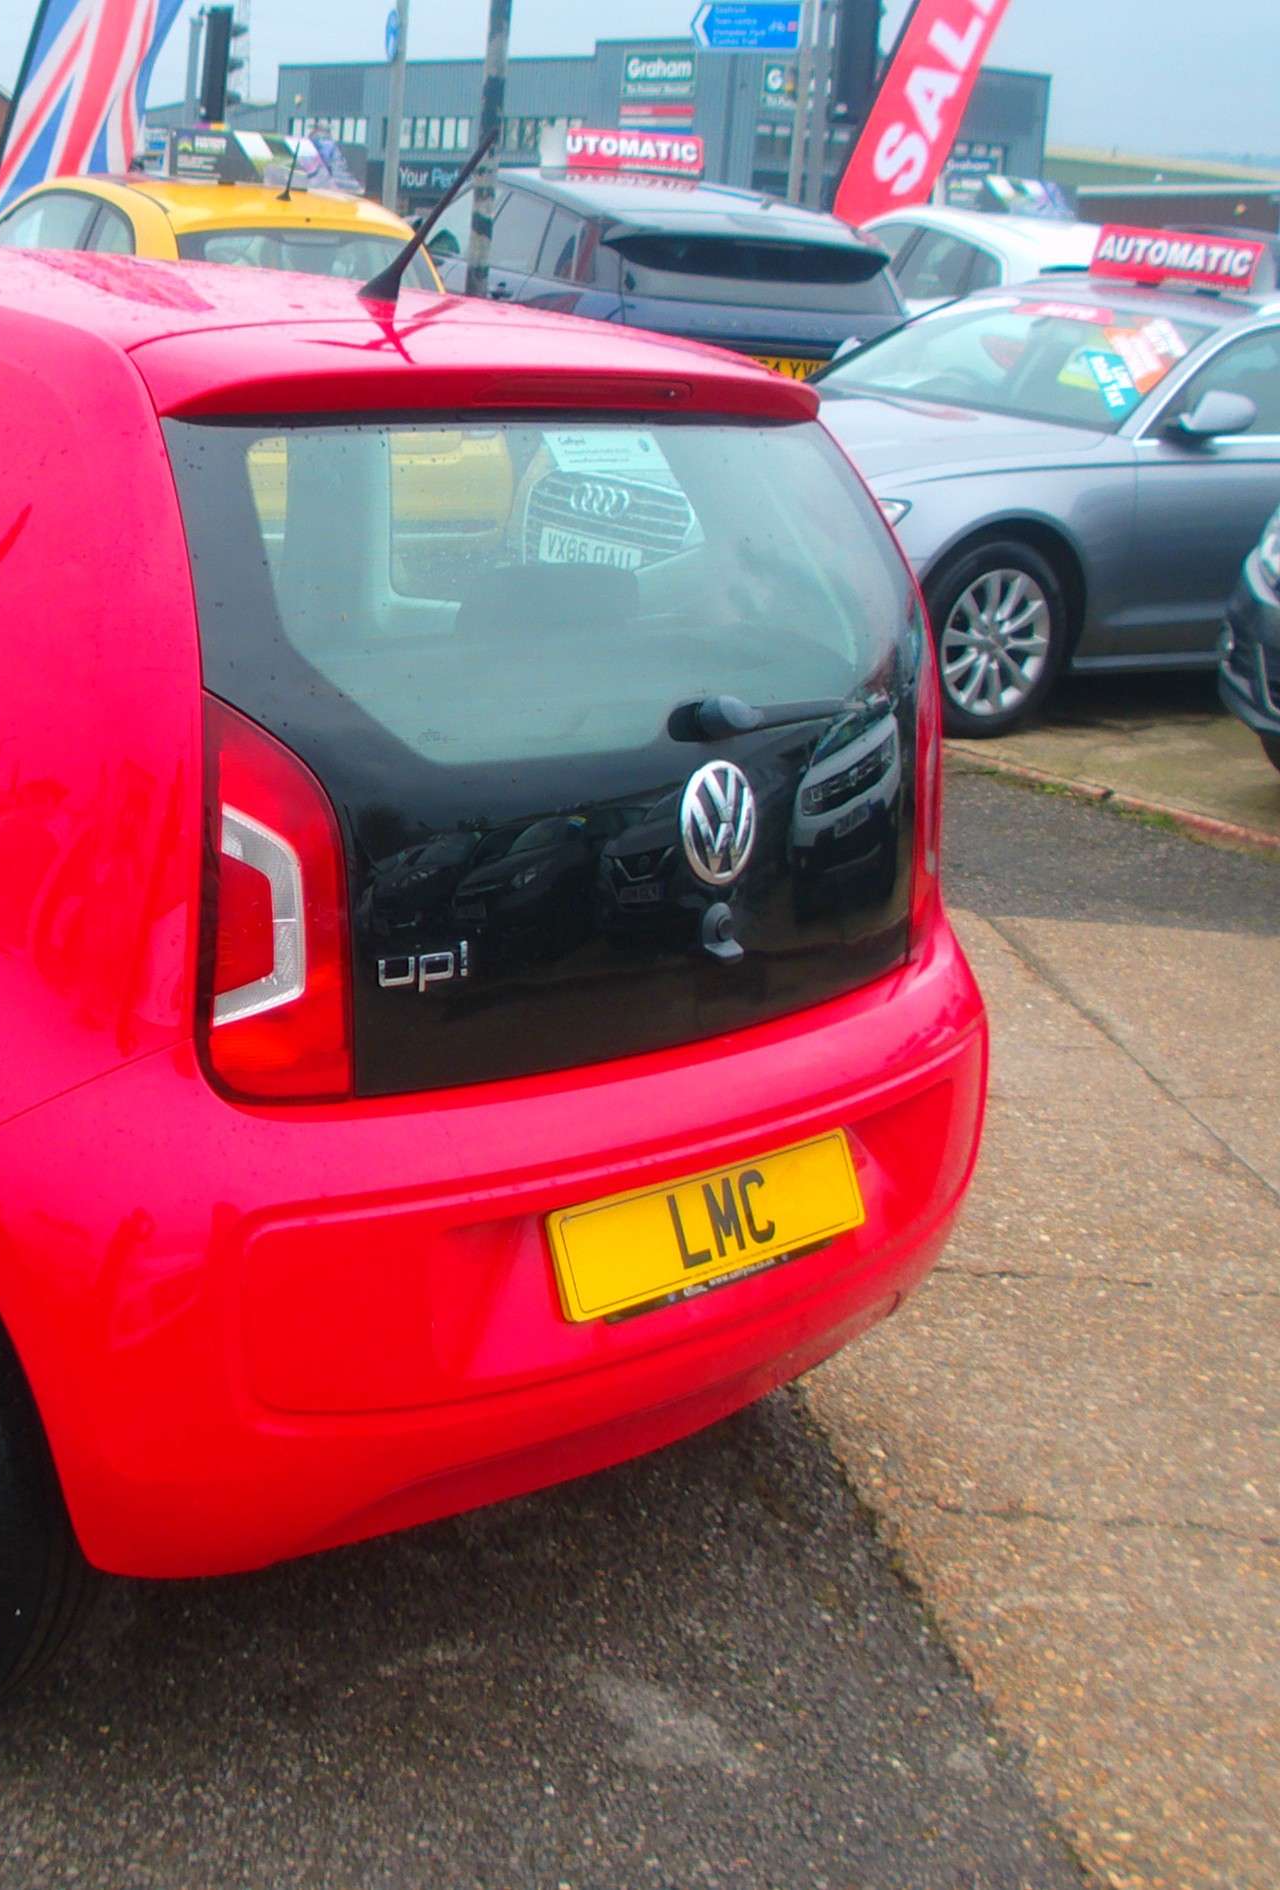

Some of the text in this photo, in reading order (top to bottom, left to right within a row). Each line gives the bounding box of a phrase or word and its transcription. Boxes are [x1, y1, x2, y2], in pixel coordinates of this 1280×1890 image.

[627, 57, 692, 78] Graham
[400, 166, 429, 186] Your
[1098, 235, 1254, 278] AUTOMATIC
[378, 940, 468, 992] up!
[666, 1169, 775, 1270] LMC
